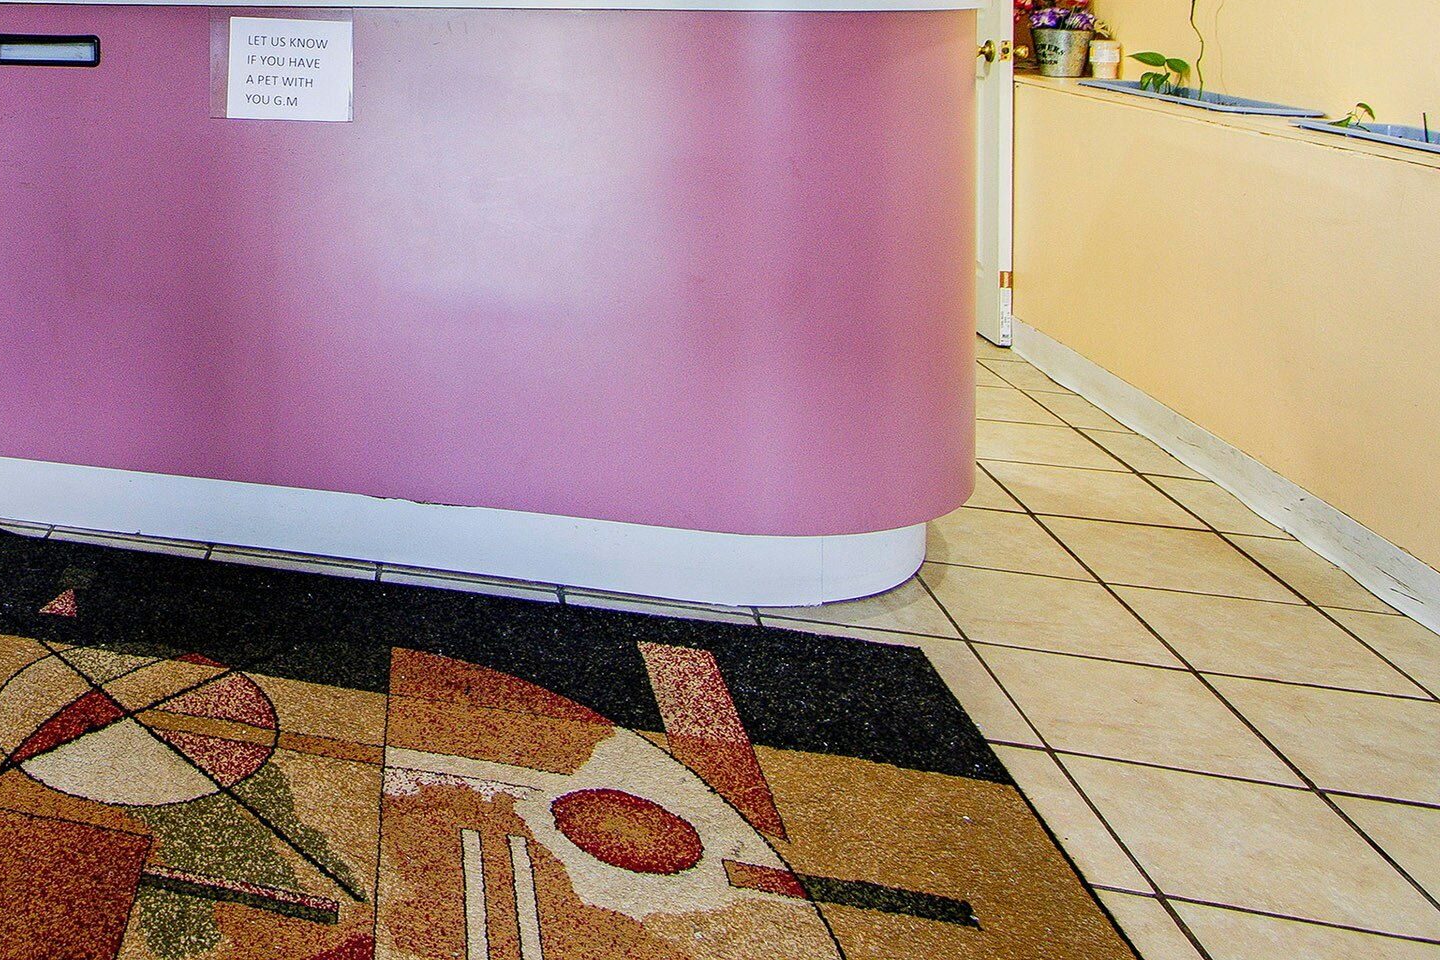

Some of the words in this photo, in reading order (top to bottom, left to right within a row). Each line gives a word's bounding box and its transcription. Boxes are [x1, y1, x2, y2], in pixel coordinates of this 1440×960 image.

[248, 35, 268, 46] LET
[271, 36, 286, 47] US
[290, 38, 328, 49] KNOW
[247, 54, 256, 64] IF
[260, 56, 285, 66] YOU
[288, 58, 320, 69] HAVE
[246, 74, 254, 84] A
[258, 75, 278, 86] PET
[282, 76, 314, 88] WITH
[245, 94, 270, 105] YOU
[274, 96, 298, 106] G.M
